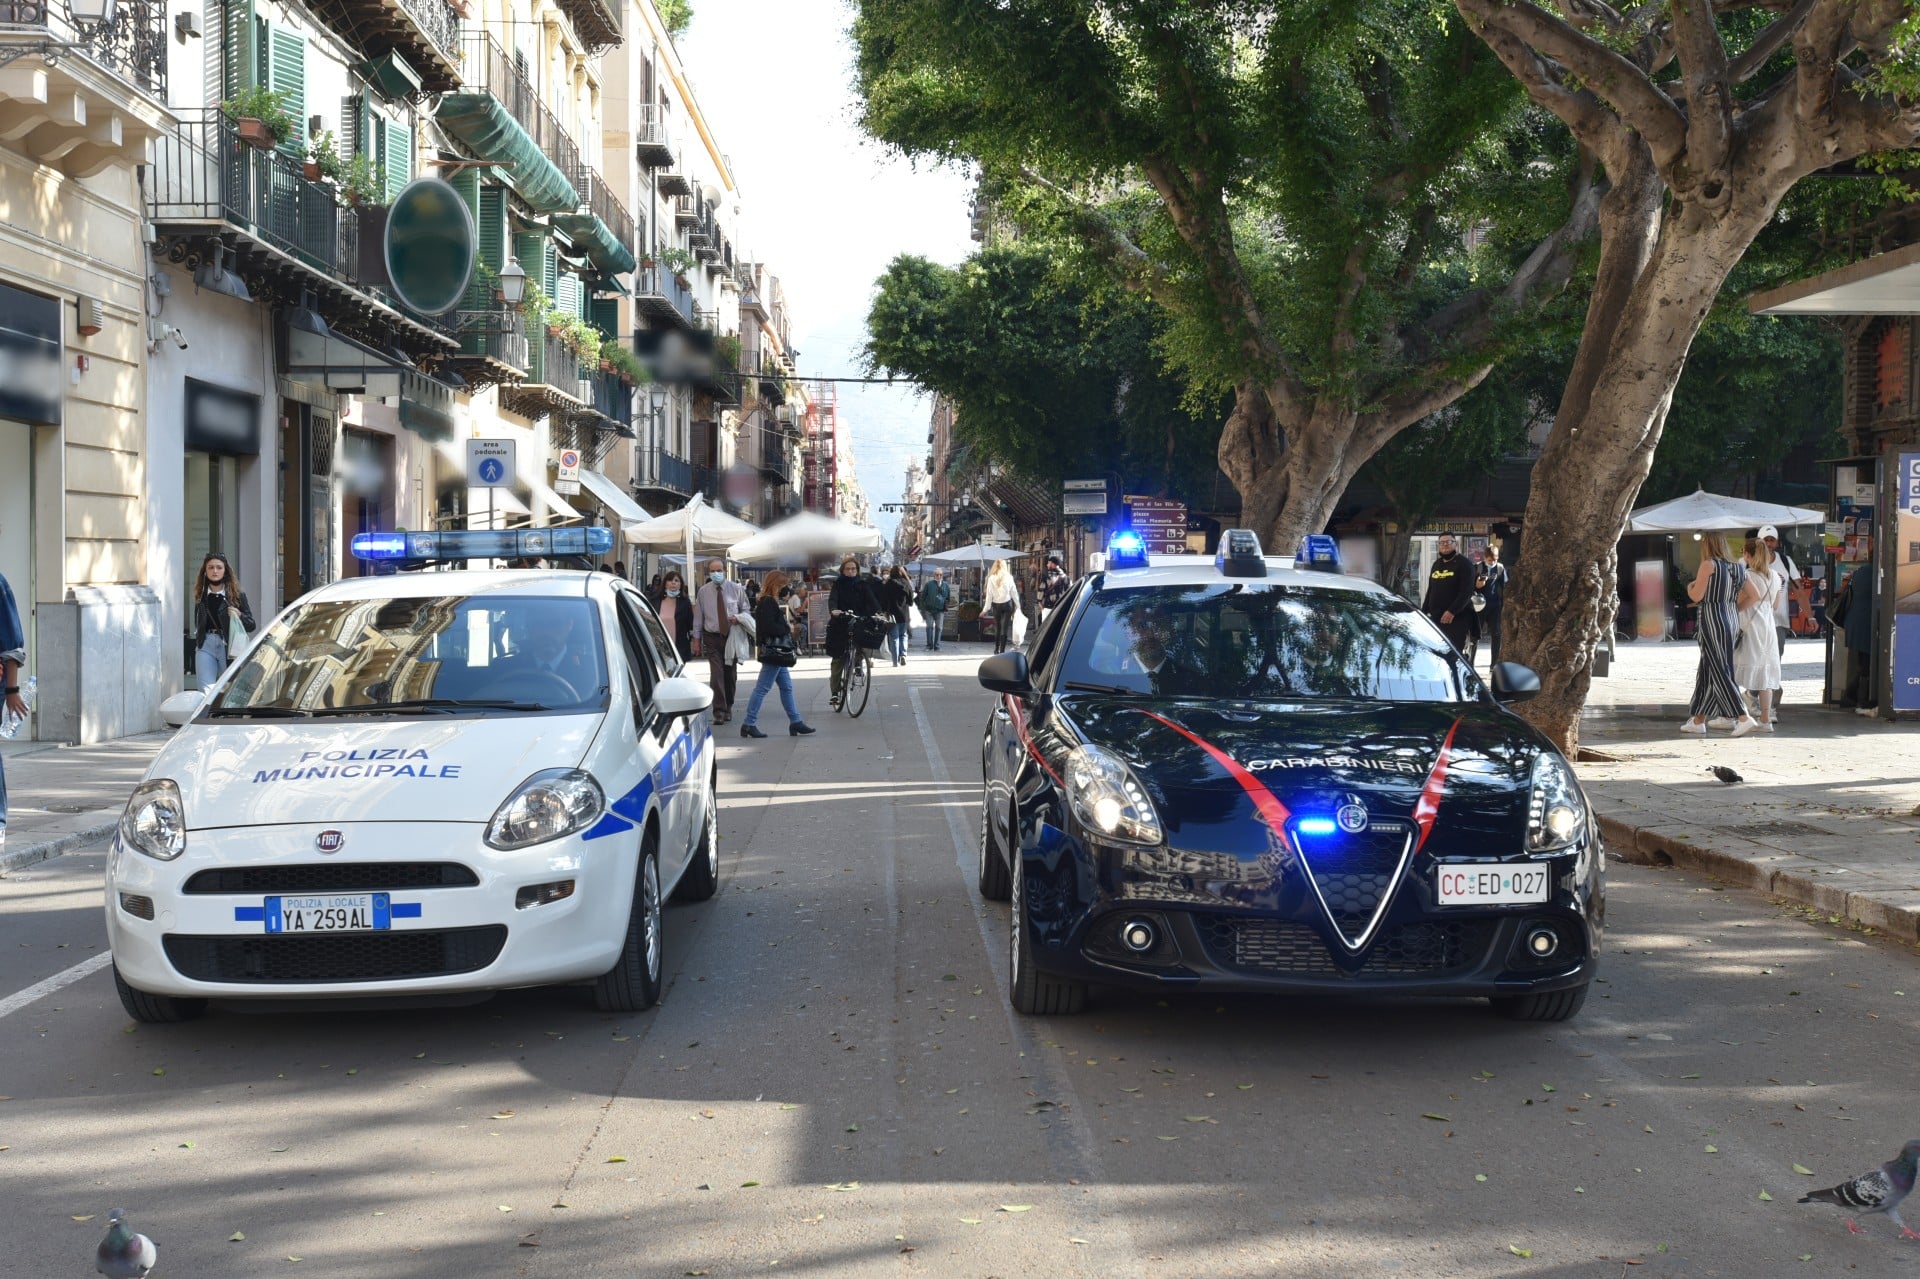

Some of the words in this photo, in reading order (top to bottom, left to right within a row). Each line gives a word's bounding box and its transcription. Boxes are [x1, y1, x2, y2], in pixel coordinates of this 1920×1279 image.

[299, 748, 430, 763] POLIZIA
[1248, 757, 1424, 773] CARABINIERI
[252, 764, 462, 784] MUNICIPALE
[321, 834, 339, 847] FIAT
[1442, 873, 1465, 896] CC
[1478, 873, 1501, 895] ED
[1512, 872, 1545, 894] 027
[287, 898, 323, 909] POLIZIA
[328, 897, 367, 907] LOCALE
